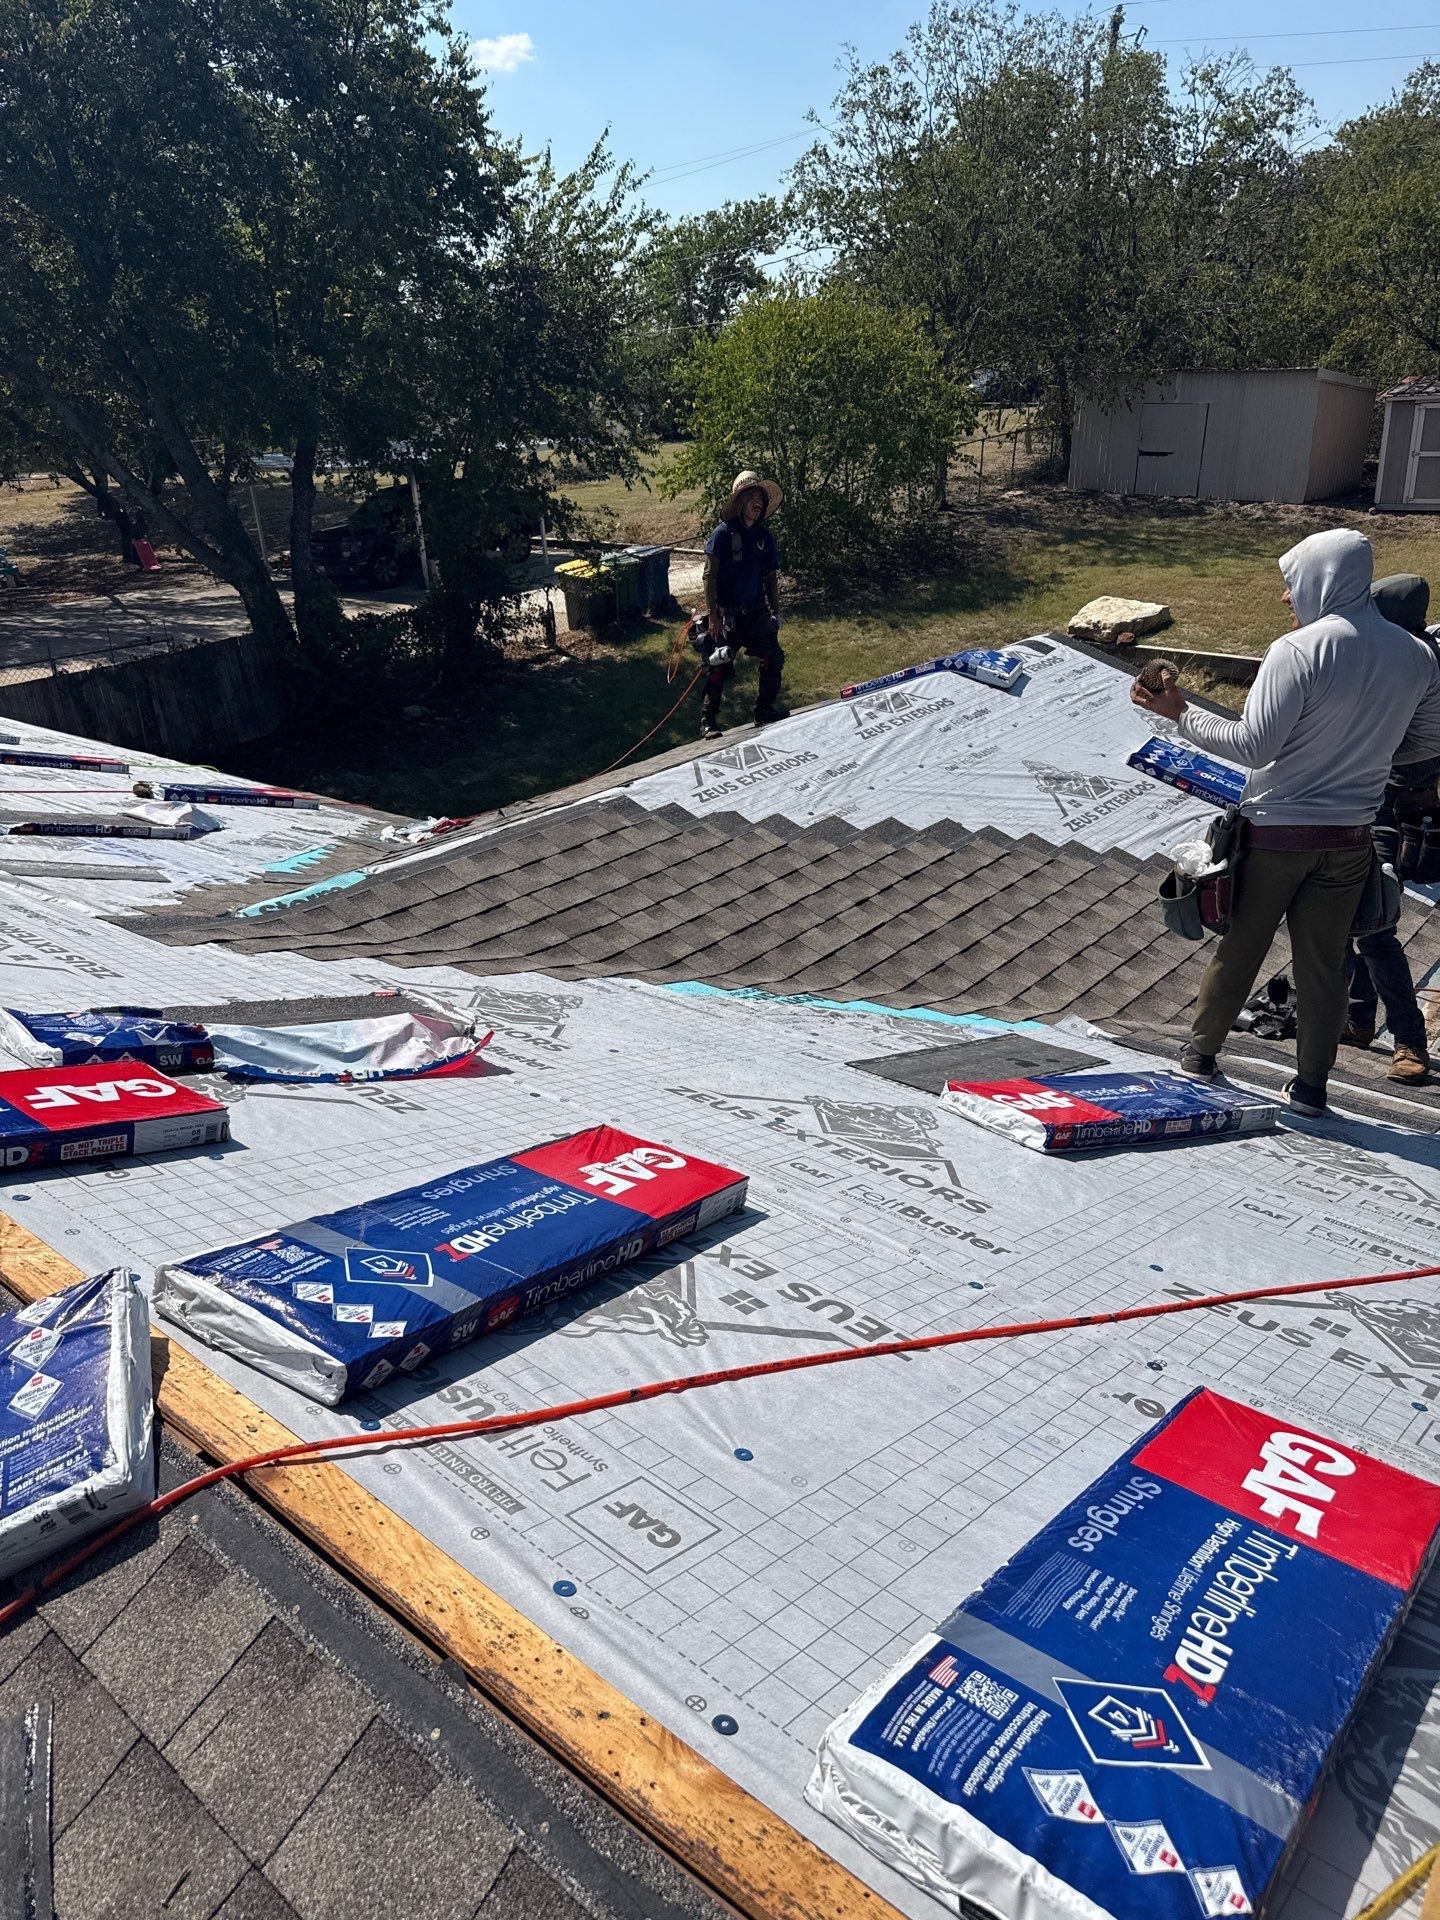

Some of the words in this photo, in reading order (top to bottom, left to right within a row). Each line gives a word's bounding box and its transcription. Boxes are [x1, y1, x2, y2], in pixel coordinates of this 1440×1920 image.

[855, 722, 893, 741] ZEUS
[888, 698, 956, 728] EXTERIORS
[691, 779, 739, 804] ZEUS
[734, 751, 820, 788] EXTERIORS
[1063, 812, 1100, 833] ZEUS
[1100, 780, 1157, 817] EXTERIORS
[54, 954, 126, 980] ZEUS
[474, 1015, 570, 1052] RIORS
[159, 1053, 182, 1066] SW
[23, 1078, 177, 1110] GAF
[991, 1091, 1076, 1111] GAF
[63, 1148, 90, 1160] STACK
[90, 1143, 125, 1156] PALLETS
[78, 1140, 96, 1151] NOT
[97, 1135, 126, 1147] TRIPLE
[664, 1085, 763, 1121] ZEUS
[762, 1121, 994, 1215] EXTERIORS
[1055, 1132, 1072, 1140] GAF
[421, 1164, 518, 1201] Shingles
[577, 1146, 688, 1196] GAF
[1295, 1180, 1341, 1197] GAF
[789, 1161, 837, 1183] GAF
[847, 1184, 1014, 1257] FeltBuster
[838, 1189, 888, 1213] Synthetic
[1242, 1202, 1291, 1222] GAF
[435, 1191, 598, 1263] TimberlineHDZ
[525, 1238, 645, 1308] TimberlineHD
[451, 1318, 479, 1342] SW
[488, 1305, 516, 1327] GAF
[1161, 1281, 1316, 1348] ZEUS
[467, 1377, 496, 1395] Felt
[541, 1424, 610, 1475] Synthetic
[8, 1476, 35, 1497] MADE
[468, 1471, 515, 1511] FIELTRO
[1240, 1431, 1357, 1539] GAF
[602, 1499, 682, 1549] GAF
[1068, 1475, 1164, 1553] Shingles
[1212, 1518, 1241, 1537] High
[1187, 1529, 1227, 1573] Definition
[1166, 1566, 1200, 1604] Lifetime
[1149, 1599, 1178, 1642] Shingles
[1164, 1532, 1296, 1700] TimberlineHDZ
[920, 1685, 942, 1709] MADE
[904, 1711, 920, 1728] THE
[909, 1695, 954, 1751] gaf.com/StrikeZone
[995, 1699, 1036, 1749] Instrucciones
[1013, 1708, 1050, 1752] Installation
[982, 1747, 1020, 1793] instructions
[986, 1744, 1000, 1758] de
[960, 1755, 995, 1796] instalación
